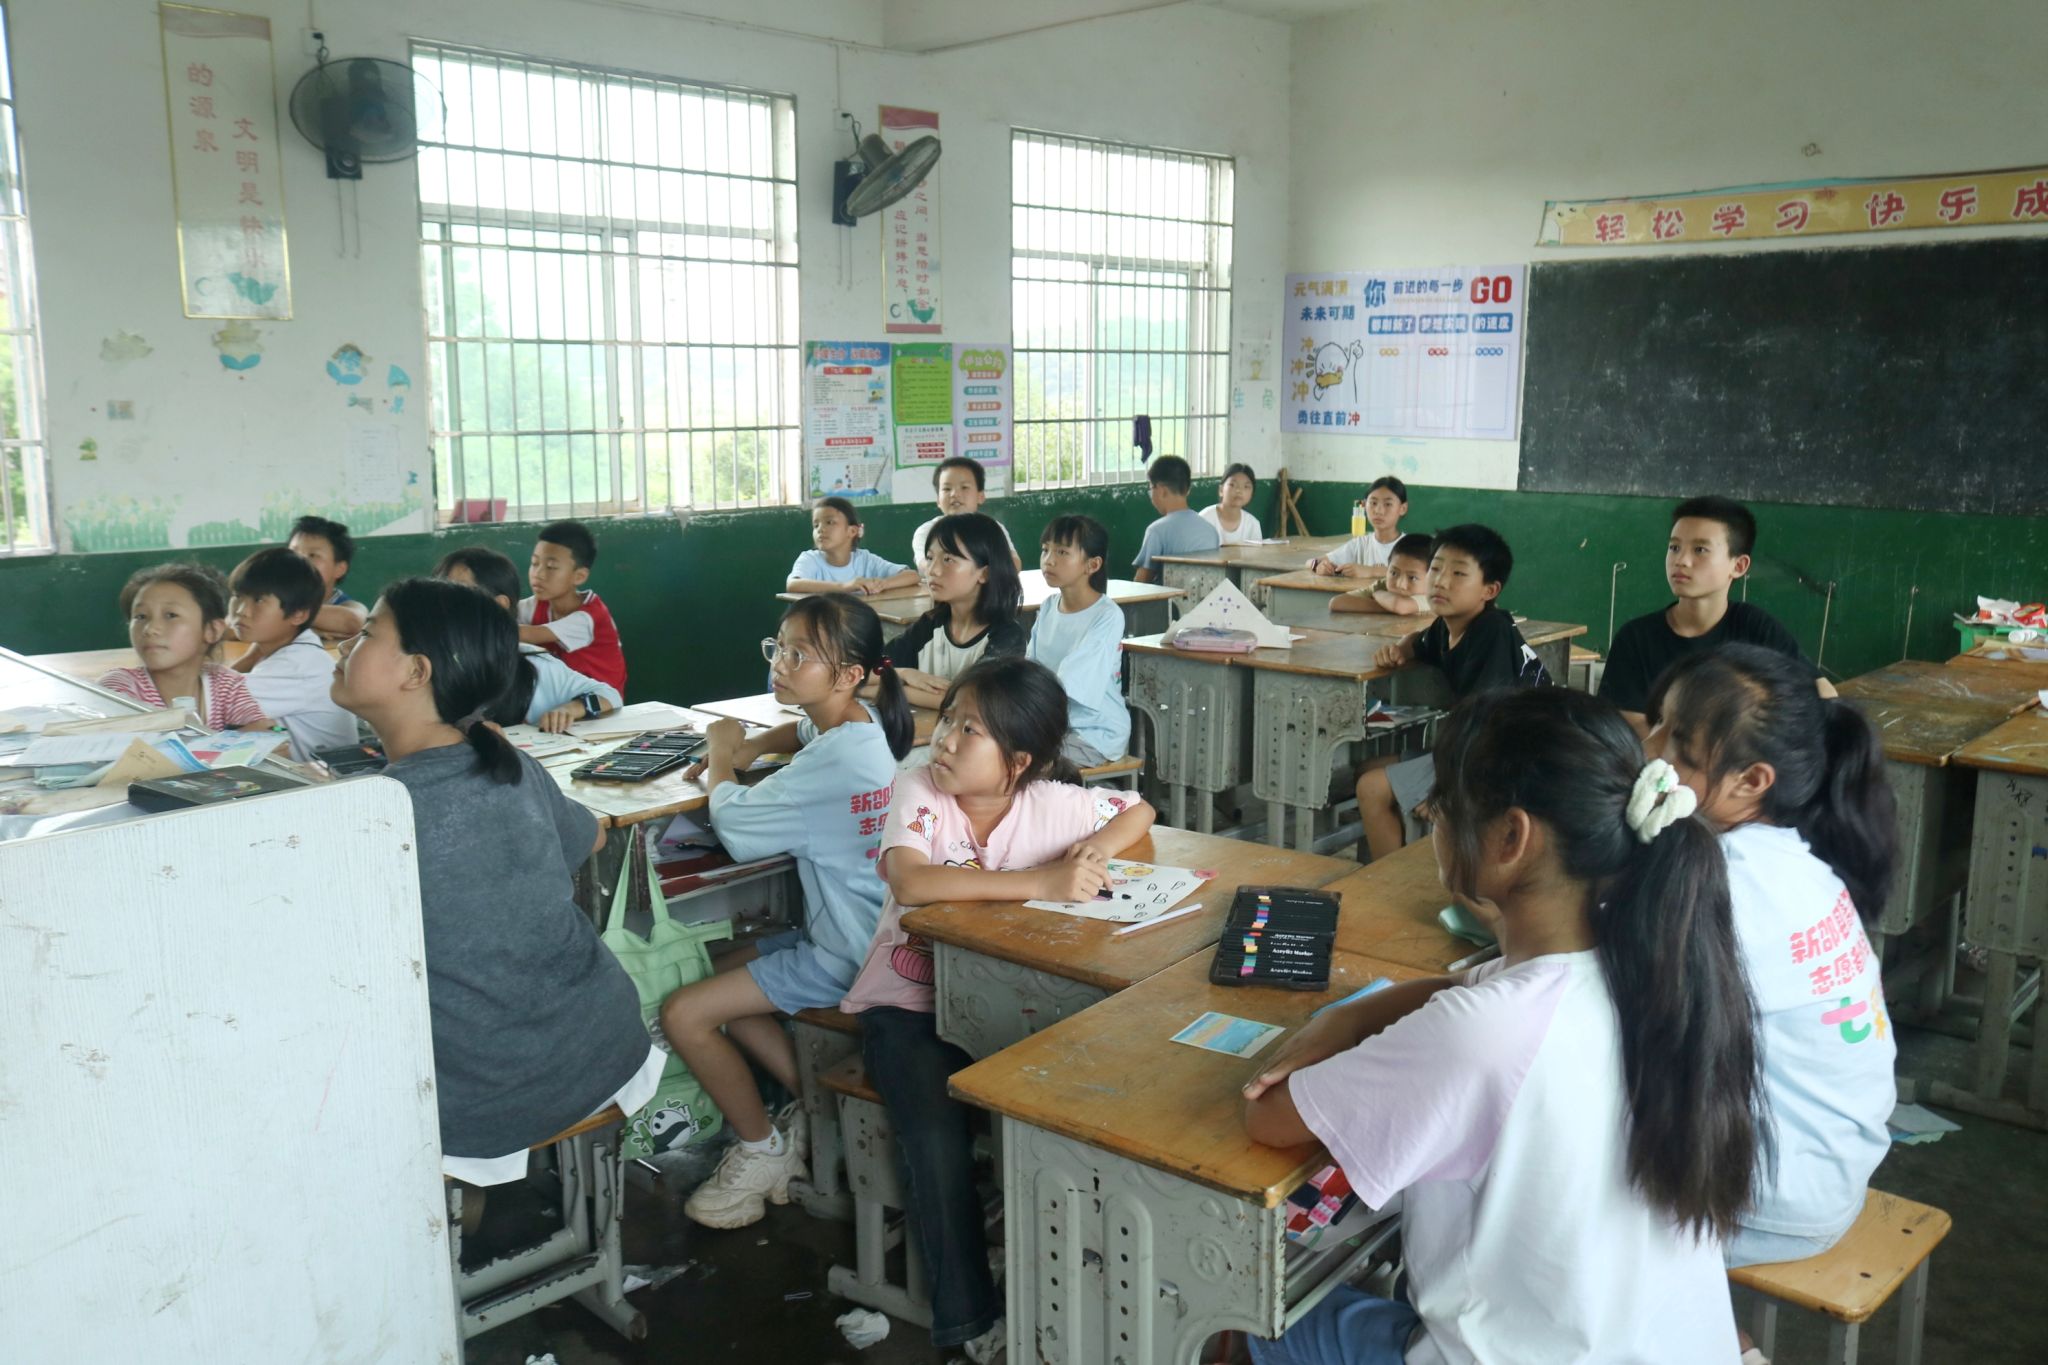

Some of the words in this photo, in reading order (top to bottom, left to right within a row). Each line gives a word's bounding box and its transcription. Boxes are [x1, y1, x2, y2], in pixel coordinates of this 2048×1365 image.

[187, 62, 219, 152] 的源泉
[232, 117, 268, 269] 文明是快乐
[1594, 197, 1811, 243] 轻松学习
[1865, 178, 2048, 228] 快乐成
[1294, 279, 1350, 297] 元气满满
[1363, 278, 1386, 309] 你
[1392, 278, 1464, 295] 前进的每一步
[1470, 275, 1513, 304] GO
[1300, 304, 1355, 321] 未来可期
[1297, 409, 1361, 426] 勇往直前冲
